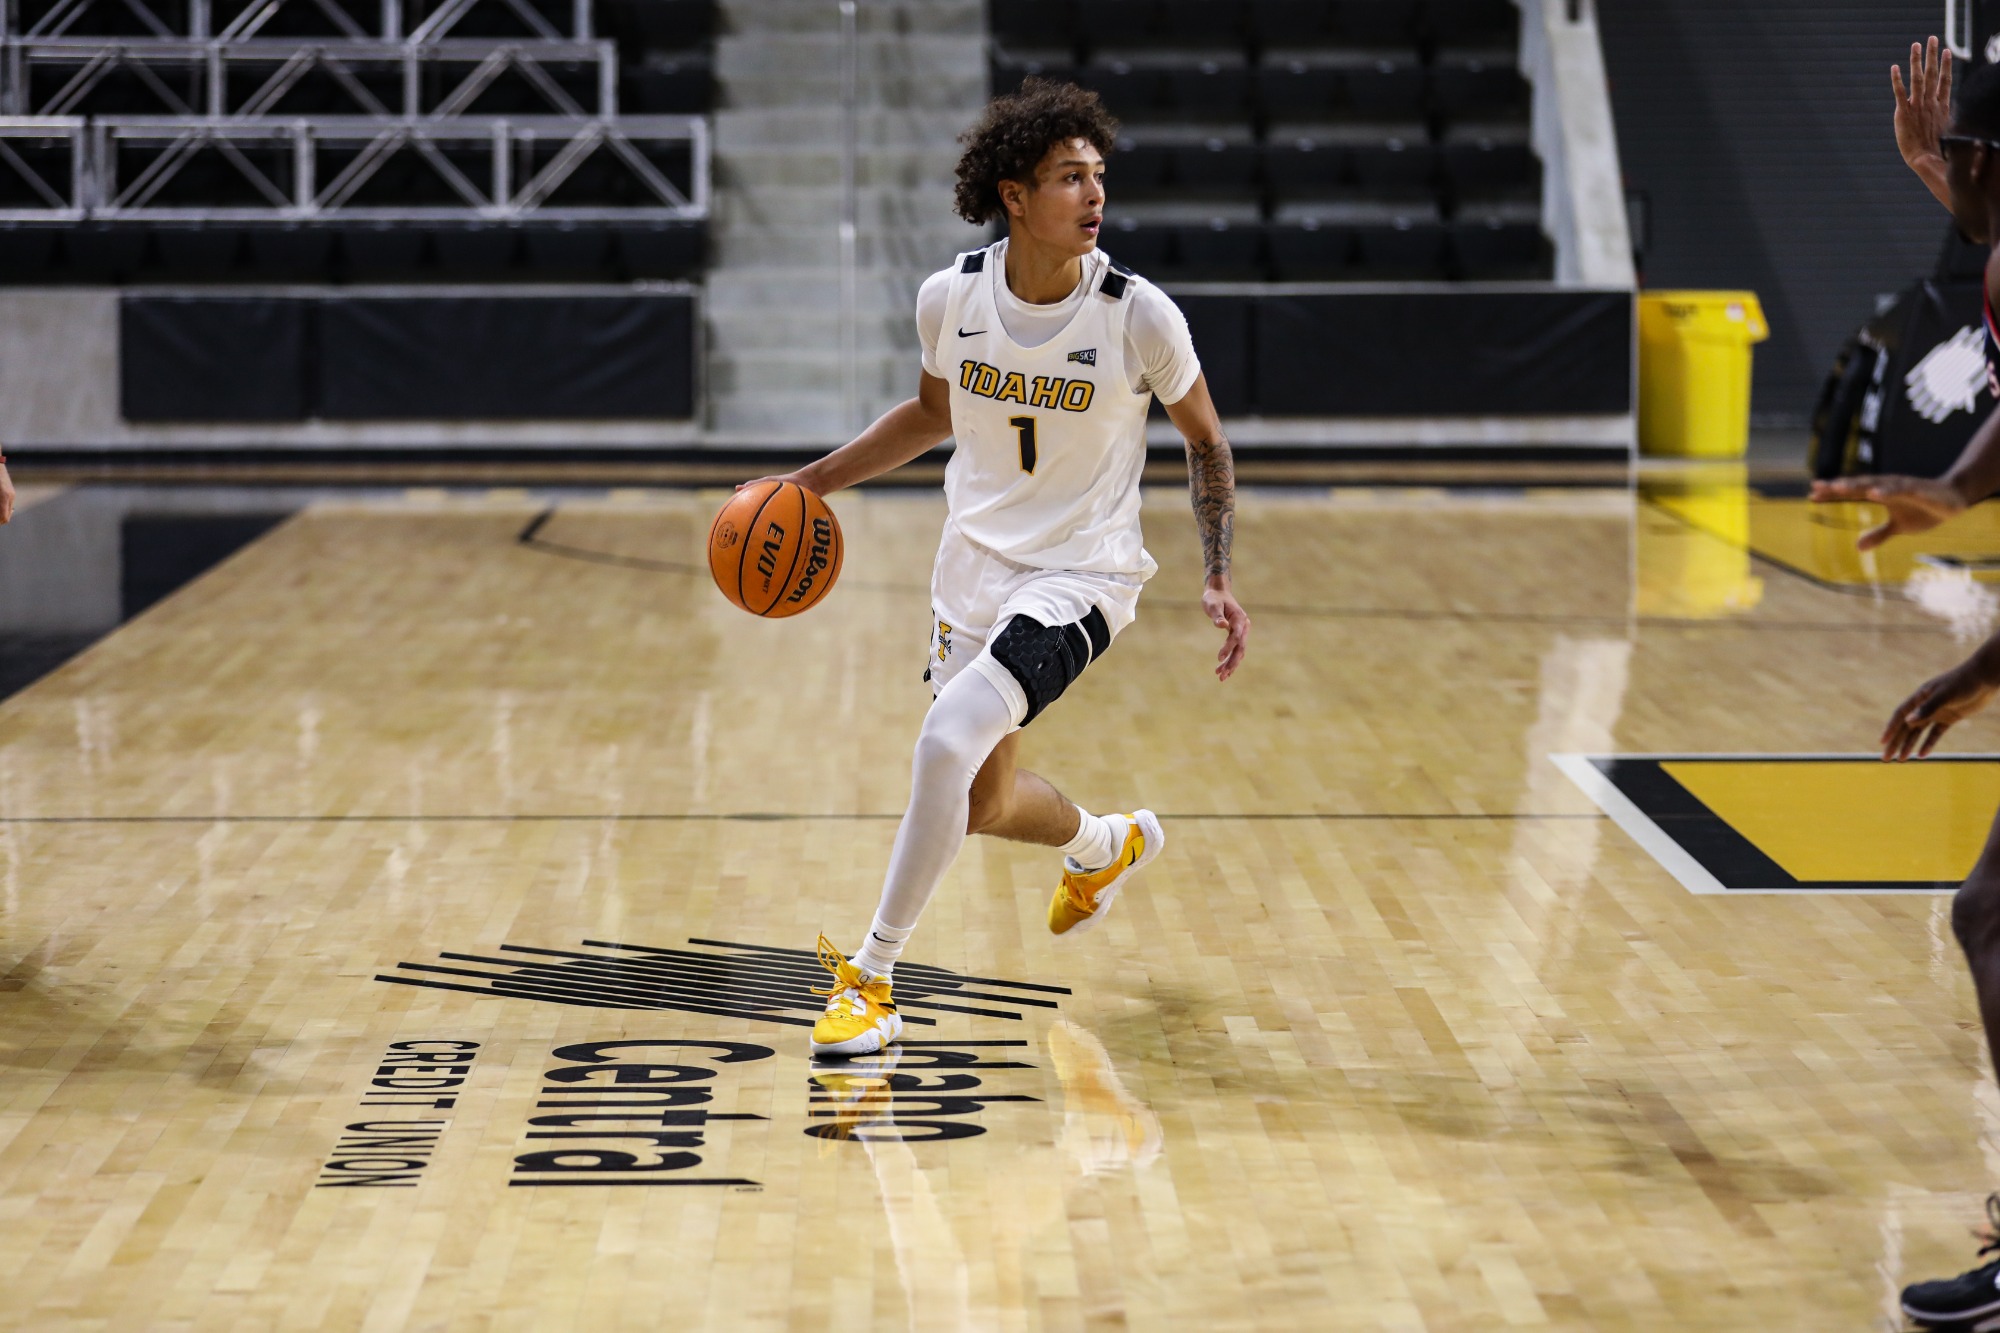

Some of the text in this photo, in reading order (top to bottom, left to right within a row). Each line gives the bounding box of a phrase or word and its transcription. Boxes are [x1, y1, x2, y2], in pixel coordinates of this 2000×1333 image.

[959, 359, 1095, 412] IDAHO
[1008, 414, 1039, 476] 1
[787, 516, 831, 603] Wilson
[315, 1040, 481, 1187] CREDIT UNION
[508, 1039, 776, 1186] Central
[803, 1040, 1045, 1141] Idaho
